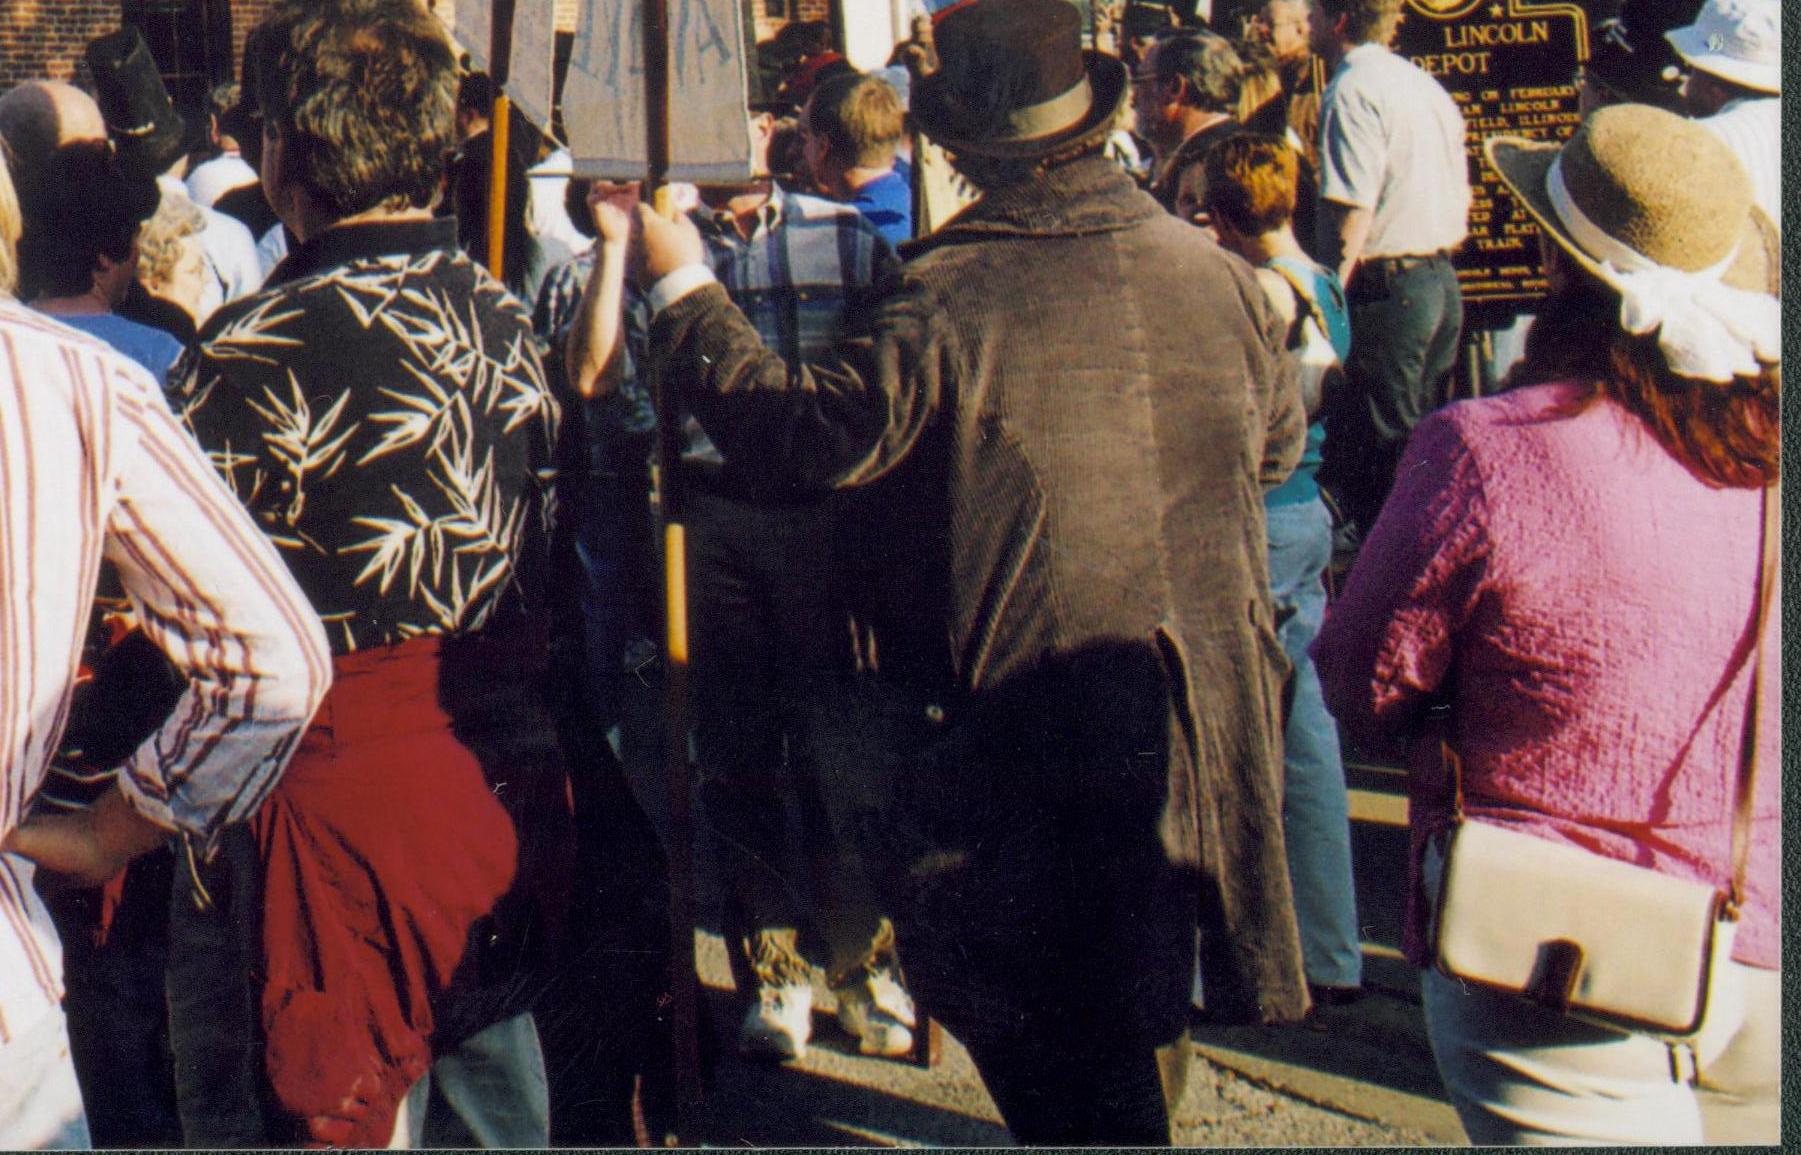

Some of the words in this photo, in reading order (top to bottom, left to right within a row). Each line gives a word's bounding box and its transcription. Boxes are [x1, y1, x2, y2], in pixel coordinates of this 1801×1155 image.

[1444, 21, 1549, 47] LINCOLN
[1410, 52, 1491, 75] DEPOT
[1500, 99, 1561, 114] LINCOLN
